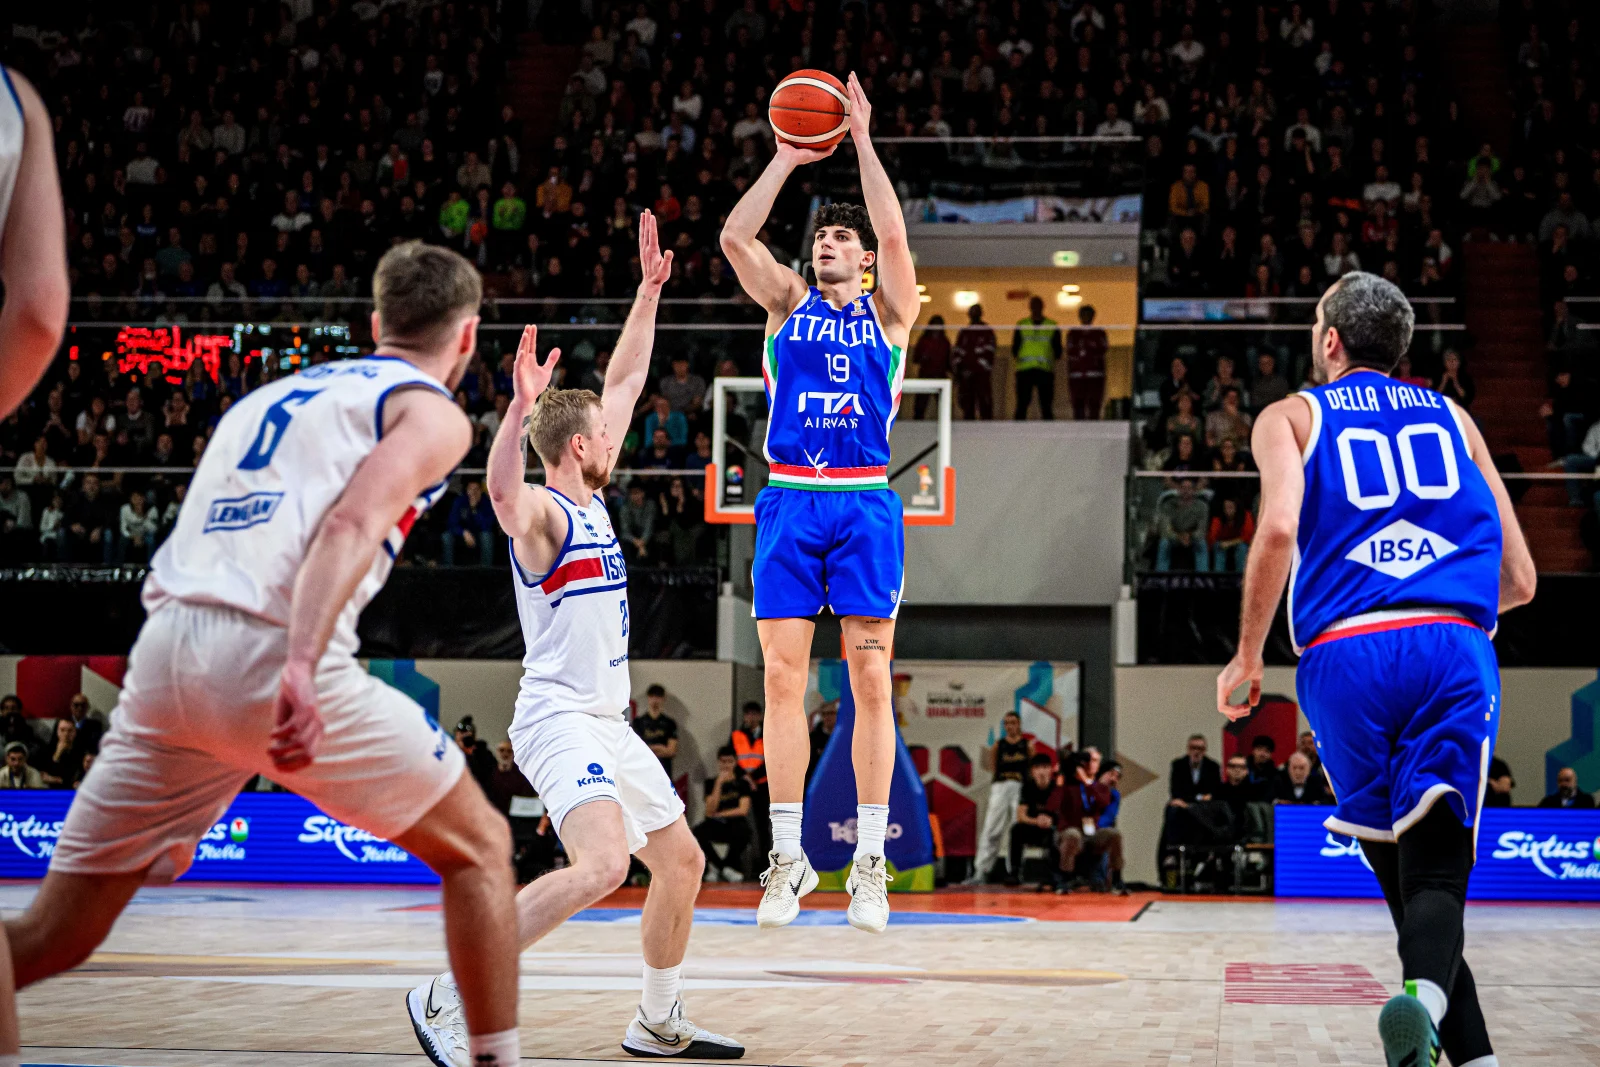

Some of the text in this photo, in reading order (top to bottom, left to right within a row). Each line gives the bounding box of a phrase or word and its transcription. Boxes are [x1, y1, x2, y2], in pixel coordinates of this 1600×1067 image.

[789, 313, 877, 348] ITALIA
[824, 353, 850, 383] 19
[797, 391, 866, 416] ITA
[1324, 385, 1442, 412] DELLA VALLE
[237, 387, 326, 471] 6
[1336, 422, 1461, 512] 00
[1369, 537, 1438, 564] IBSA
[1492, 830, 1589, 879] Sixtus
[1559, 862, 1600, 880] Itali
